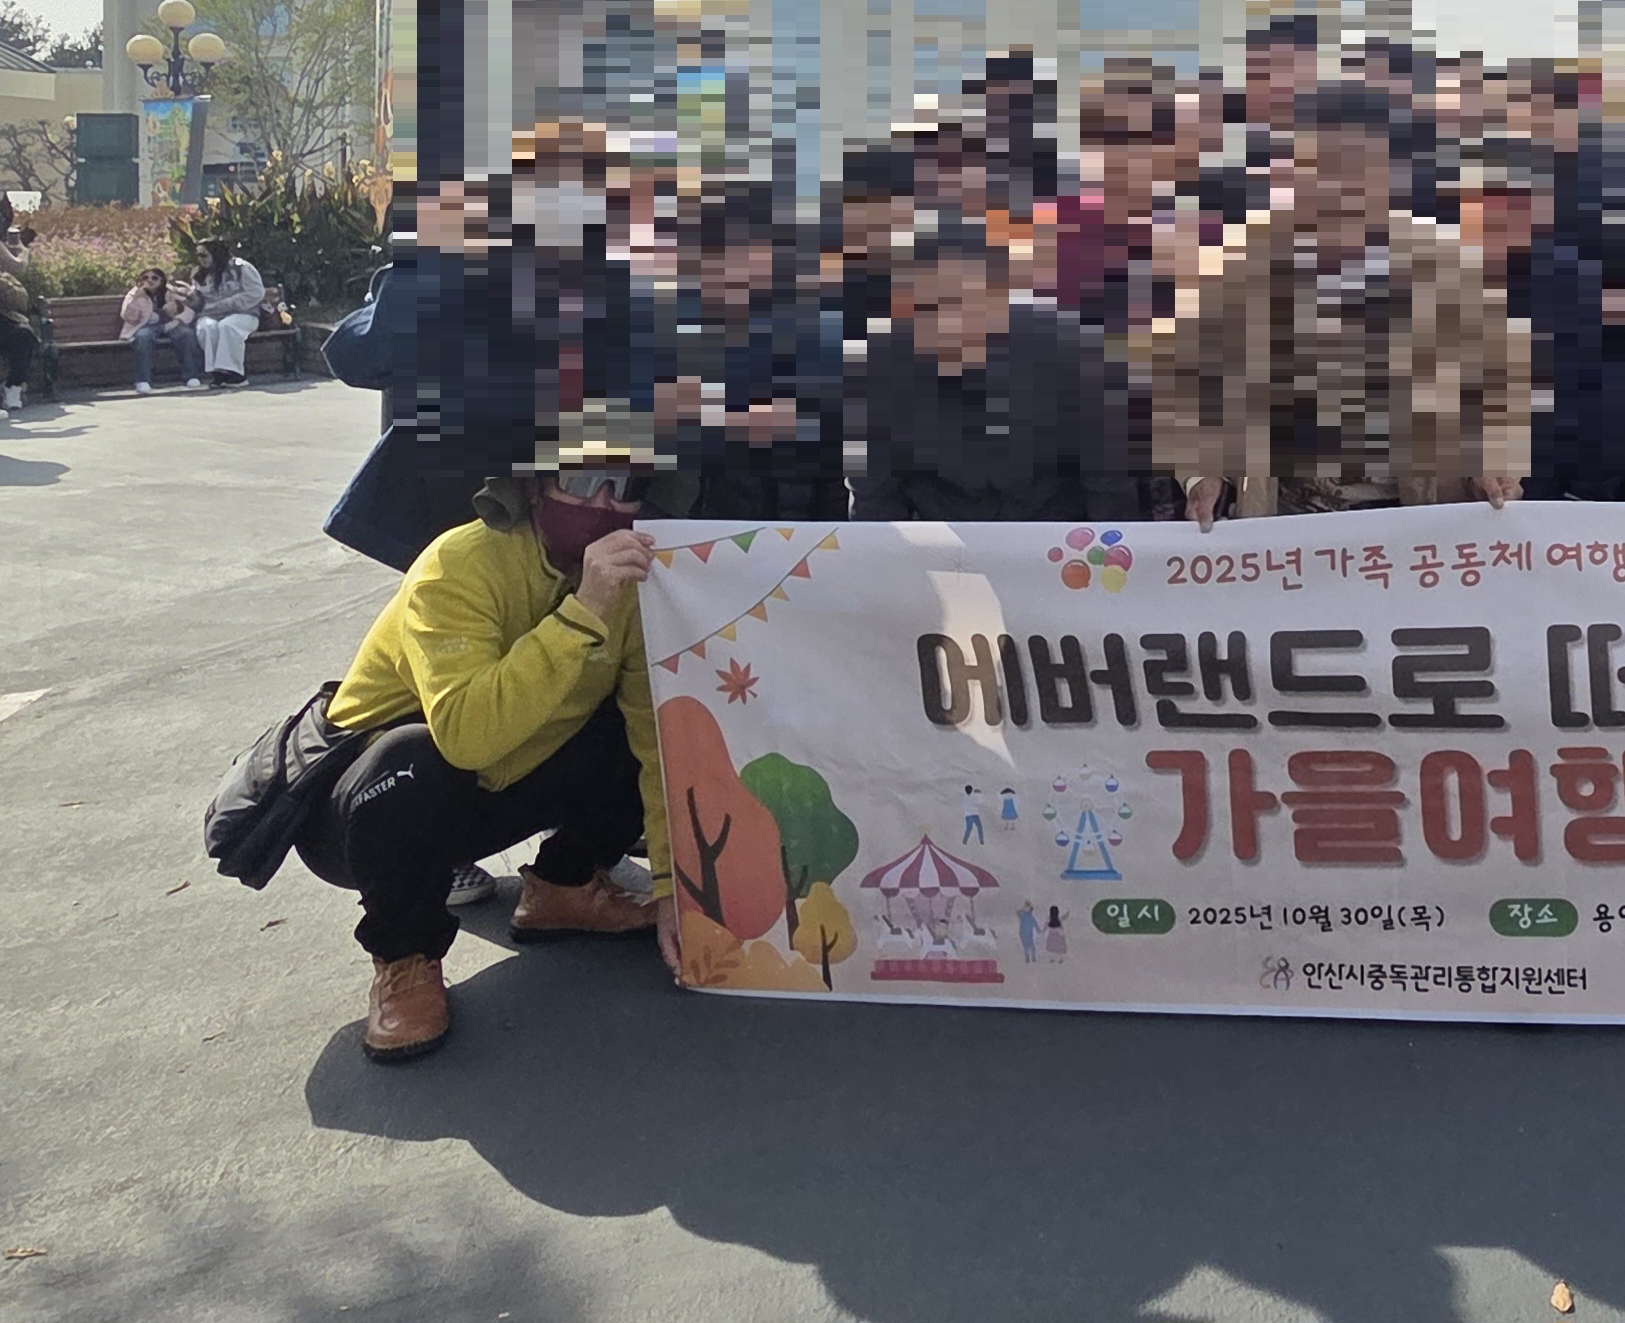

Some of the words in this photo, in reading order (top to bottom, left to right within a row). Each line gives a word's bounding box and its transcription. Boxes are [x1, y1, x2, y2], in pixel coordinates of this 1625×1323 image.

[1166, 547, 1303, 591] 2025년
[1314, 545, 1394, 590] 가족
[1409, 540, 1532, 588] 공동체
[916, 626, 1505, 729] 에버랜드로
[1105, 903, 1161, 928] 일시
[1188, 905, 1273, 930] 2025년
[1282, 905, 1333, 932] 10월
[1340, 904, 1446, 932] 30일(목)
[1506, 902, 1559, 929] 장소
[1302, 962, 1588, 995] 안산시중독관리통합지원센터
